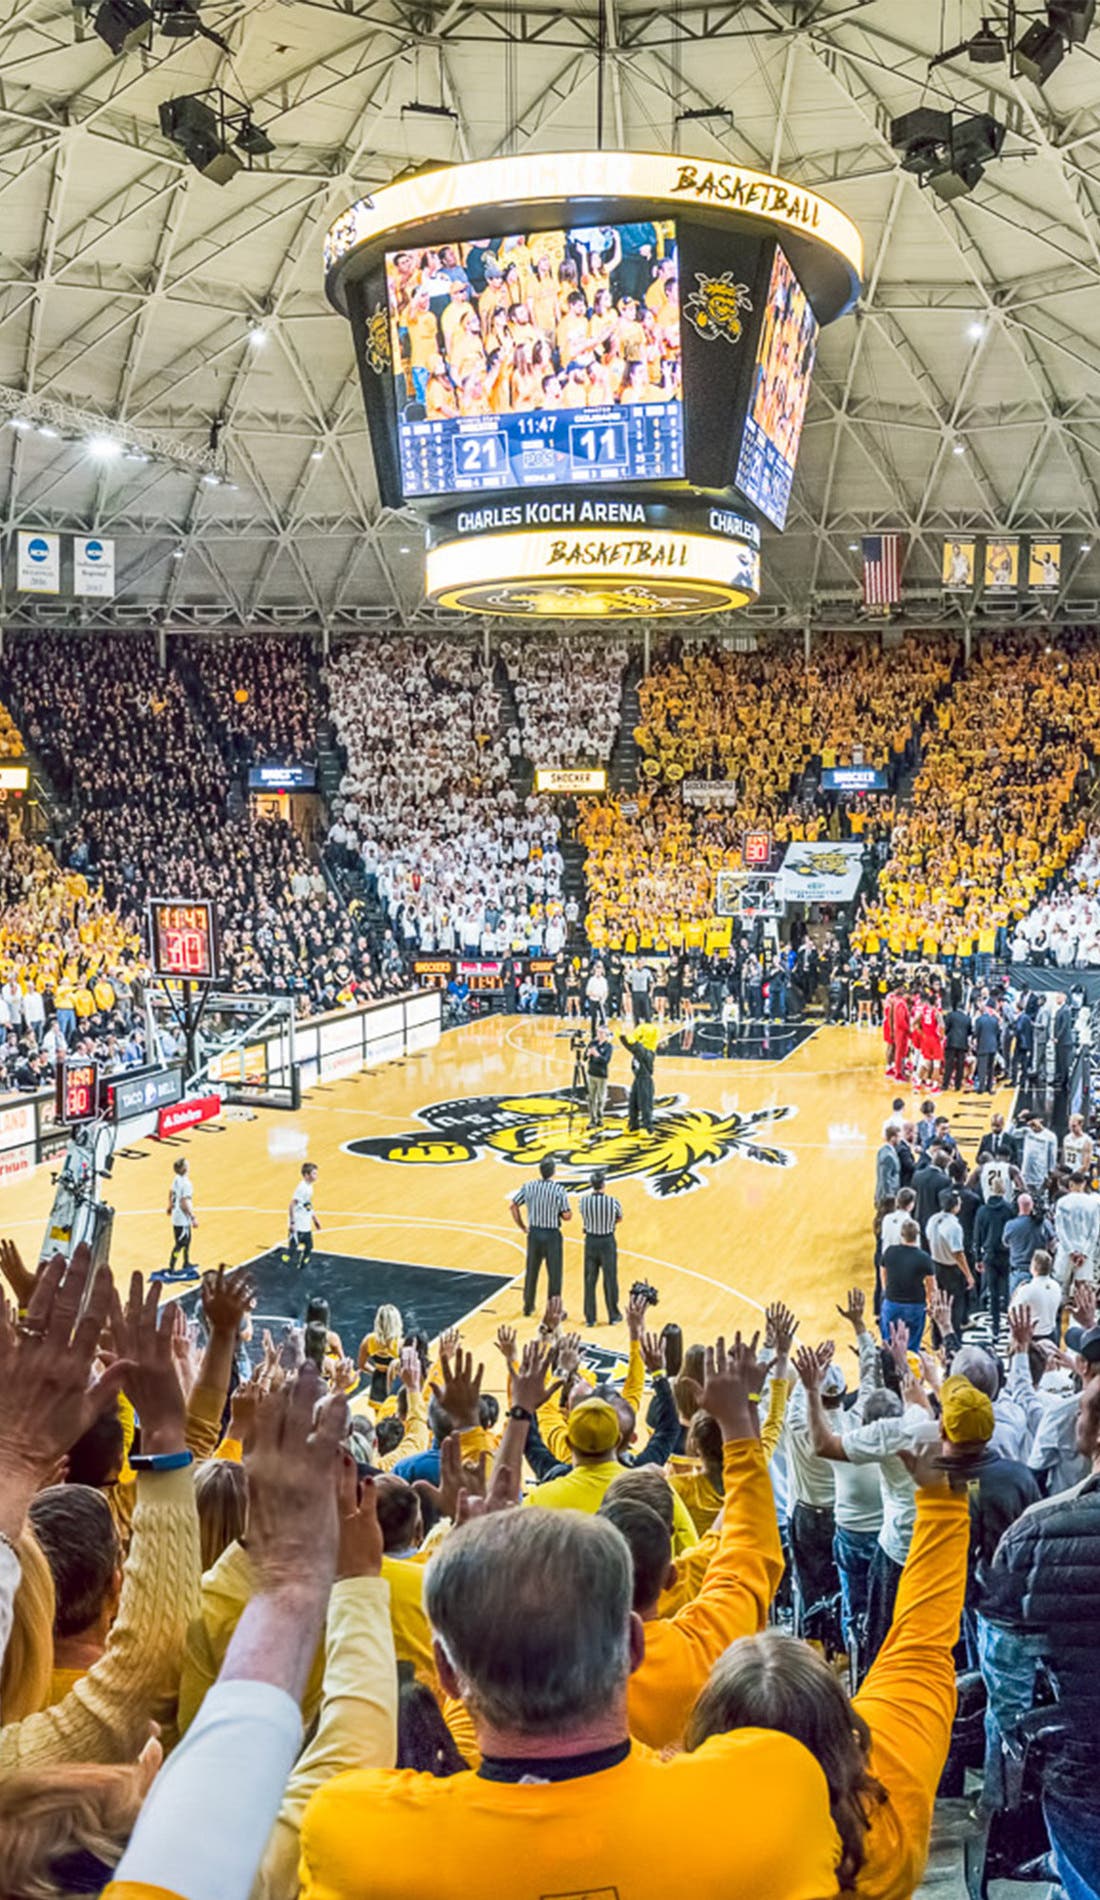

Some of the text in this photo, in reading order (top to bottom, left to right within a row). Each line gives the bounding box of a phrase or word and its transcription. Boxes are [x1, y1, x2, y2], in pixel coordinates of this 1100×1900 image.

[670, 165, 820, 227] BASKETBALL
[518, 416, 557, 434] 11:47
[462, 438, 497, 470] 21
[580, 429, 616, 461] 11
[457, 501, 646, 532] CHARLES KOCH ARENA
[546, 540, 689, 567] BASKETBALL
[550, 772, 592, 783] SHOCKER
[166, 931, 202, 969] 30
